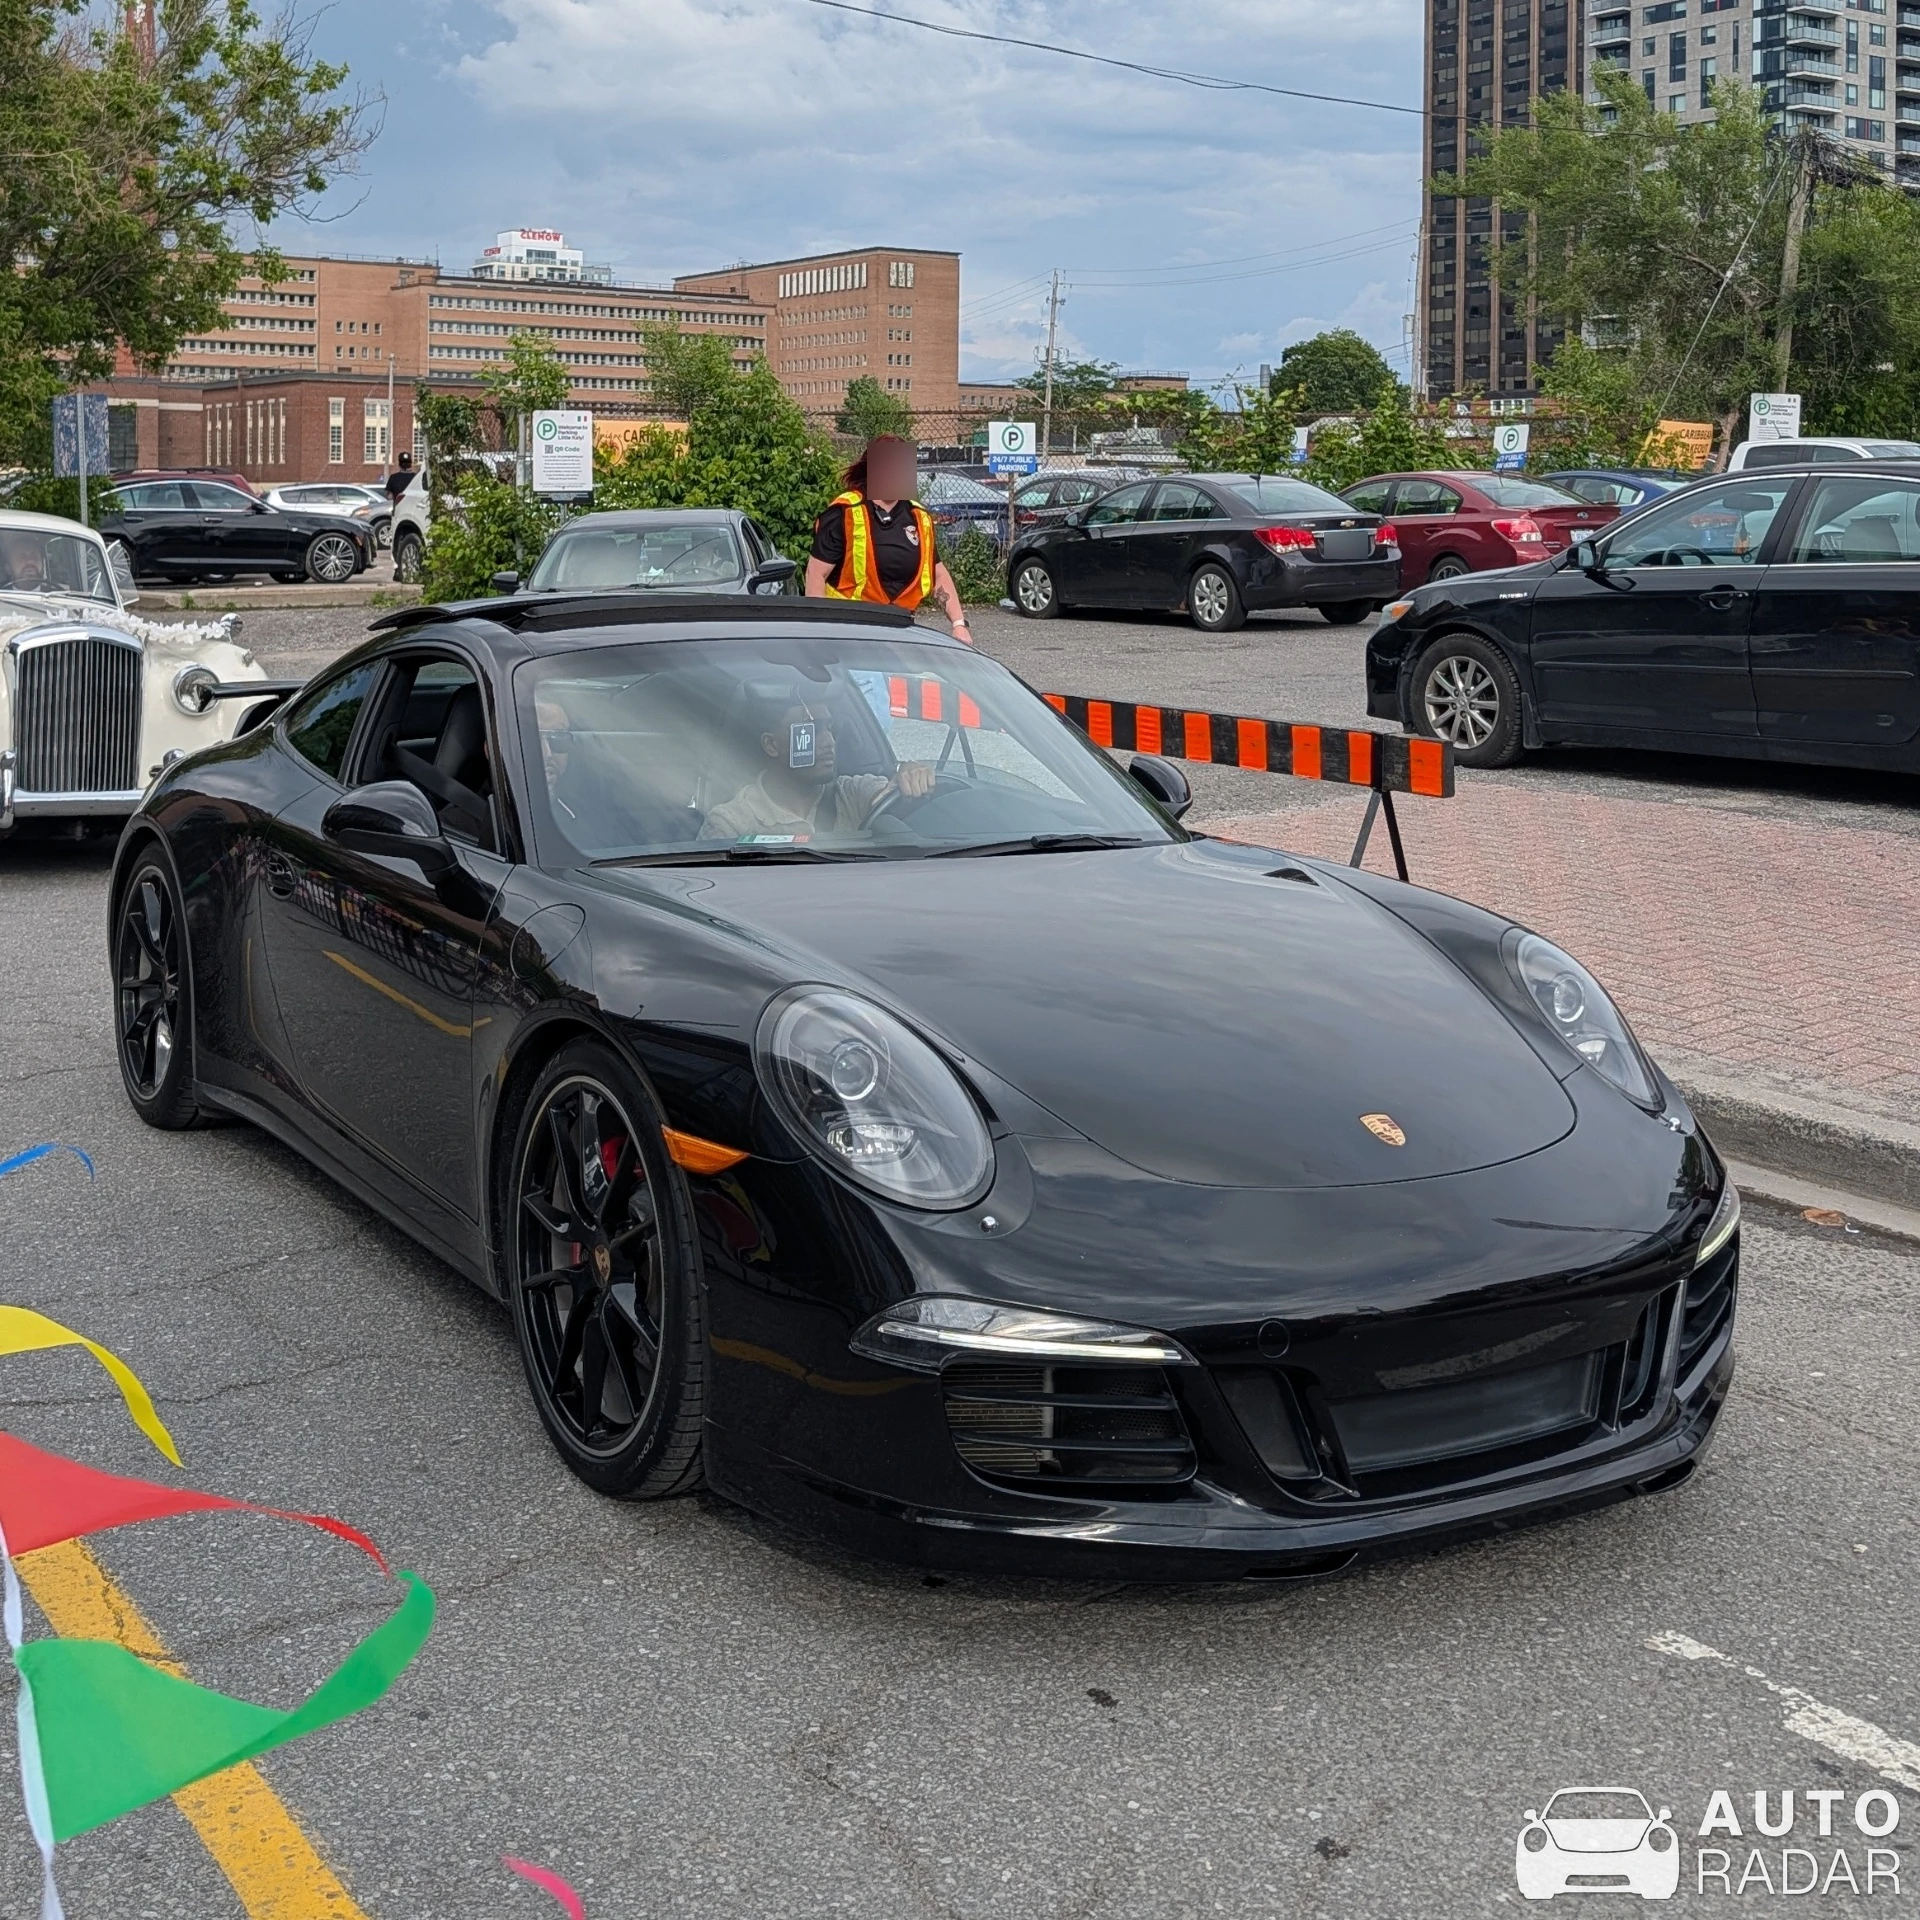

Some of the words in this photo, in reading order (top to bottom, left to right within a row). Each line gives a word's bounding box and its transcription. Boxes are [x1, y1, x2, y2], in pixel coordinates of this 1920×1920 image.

[1758, 402, 1767, 412] P
[542, 423, 553, 436] P
[1008, 431, 1019, 446] P
[1507, 433, 1515, 446] P
[796, 734, 810, 750] VIP
